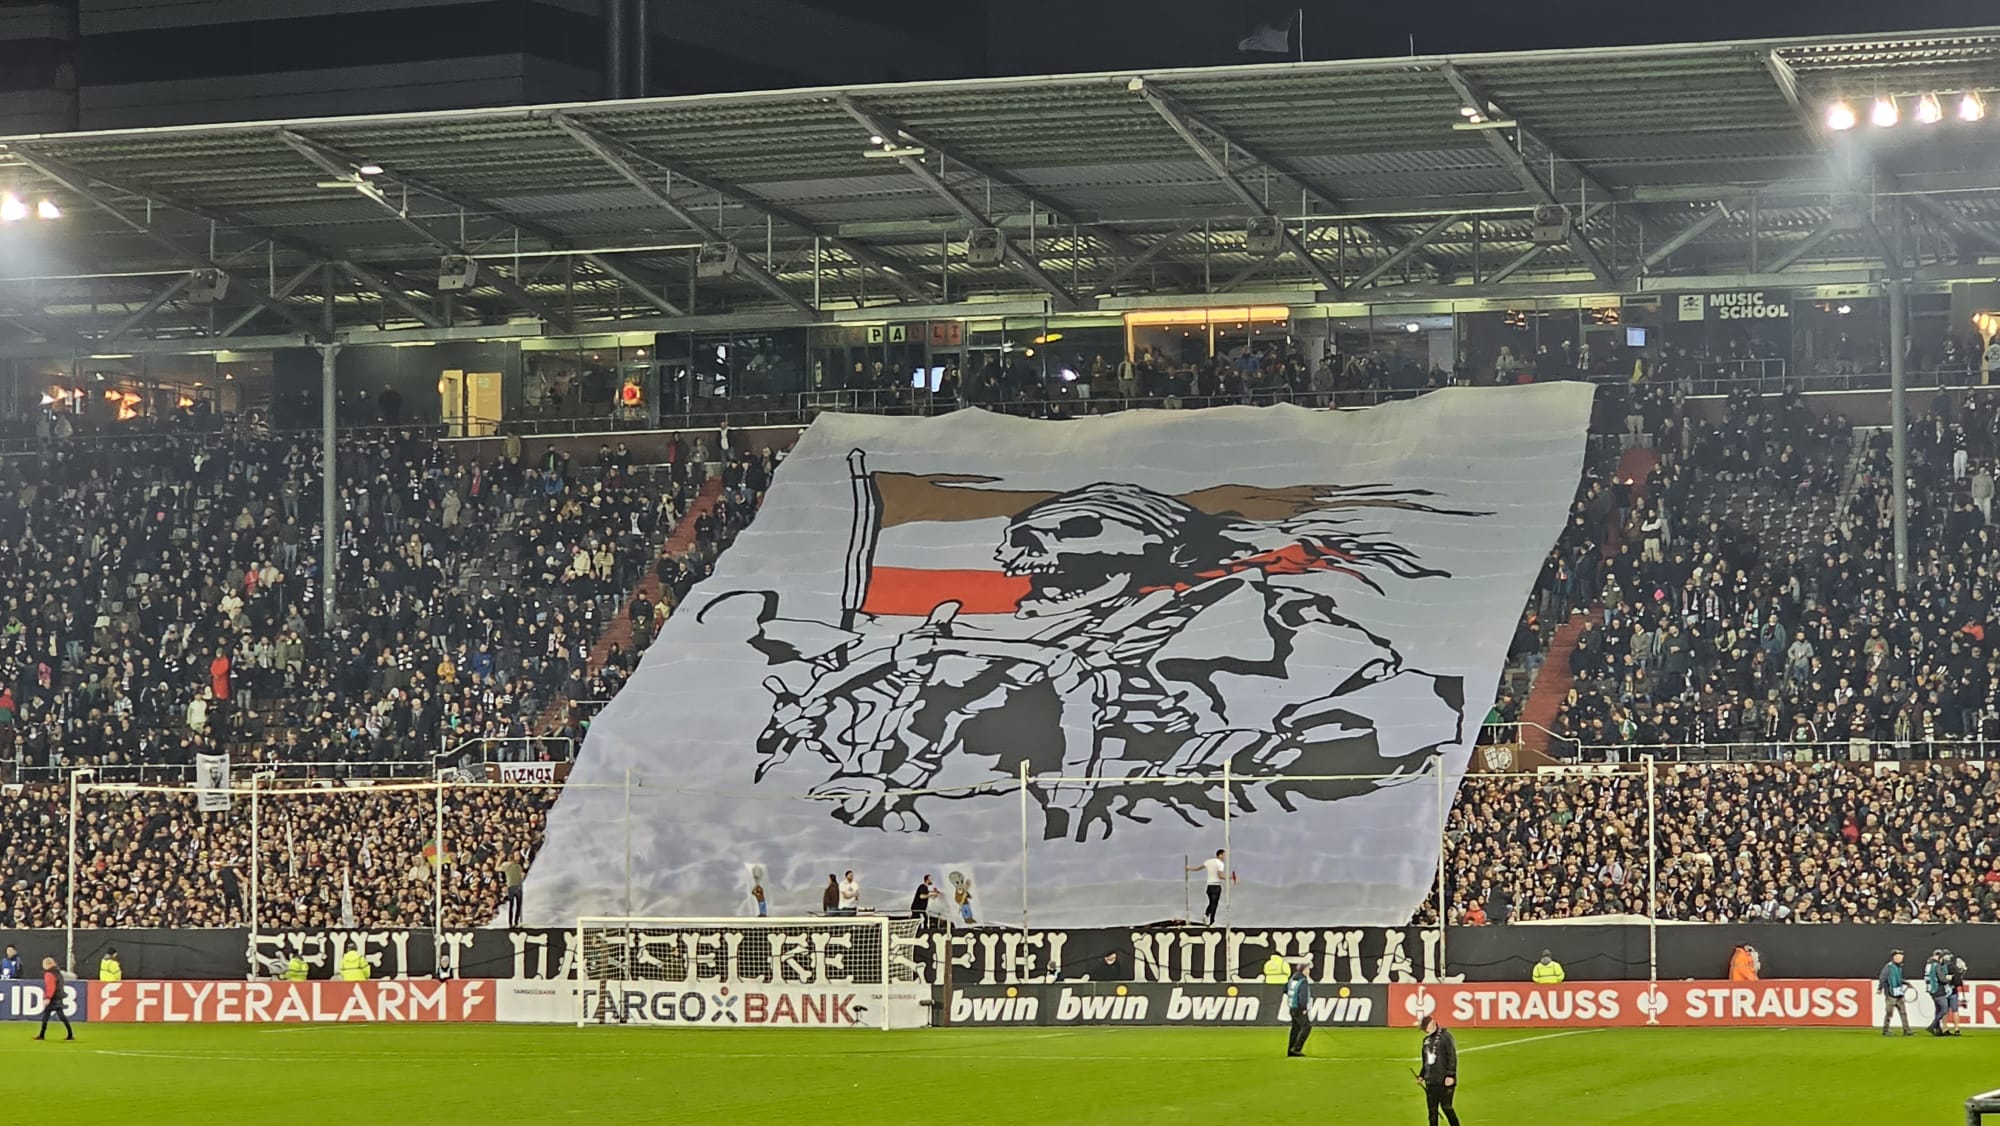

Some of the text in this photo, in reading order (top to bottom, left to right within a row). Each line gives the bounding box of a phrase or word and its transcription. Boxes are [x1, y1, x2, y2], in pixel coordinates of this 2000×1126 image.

[1710, 292, 1764, 307] MUSIC
[1720, 304, 1789, 319] SCHOOL
[872, 324, 959, 343] PAULI
[136, 983, 447, 1022] FLYERALARM
[950, 987, 1039, 1022] bwin
[1057, 986, 1149, 1020] bwin
[1166, 986, 1260, 1021] bwin
[1452, 990, 1620, 1020] STRAUSS
[1686, 987, 1859, 1018] STRAUSS
